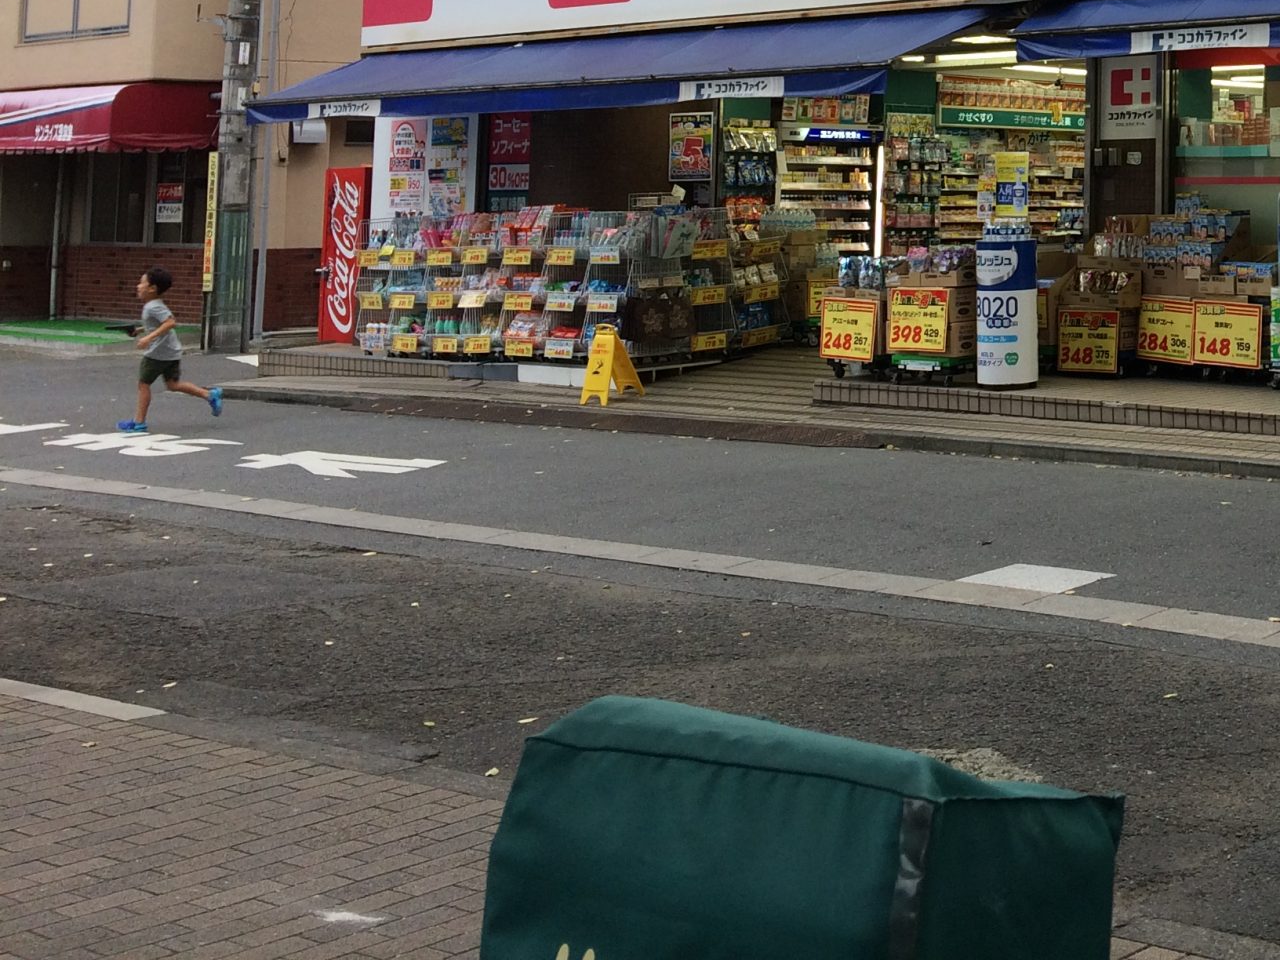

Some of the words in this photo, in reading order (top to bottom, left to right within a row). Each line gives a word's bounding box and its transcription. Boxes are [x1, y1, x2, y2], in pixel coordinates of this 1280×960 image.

[1177, 29, 1247, 44] ココカラファイン
[715, 81, 768, 93] ココカラファイン
[333, 102, 369, 113] ココカラファイン
[1108, 110, 1153, 120] ココカラファイン
[957, 113, 994, 122] かぜぐすり
[495, 120, 528, 133] コーセー
[492, 139, 530, 155] ソフィーナ
[823, 332, 852, 350] 248
[854, 337, 868, 346] 267
[891, 325, 922, 343] 398
[924, 328, 939, 338] 429
[1139, 332, 1168, 352] 284
[1170, 338, 1187, 348] 306
[1199, 336, 1231, 356] 148
[1236, 342, 1250, 351] 159
[1060, 347, 1093, 365] 348
[1095, 350, 1109, 359] 375
